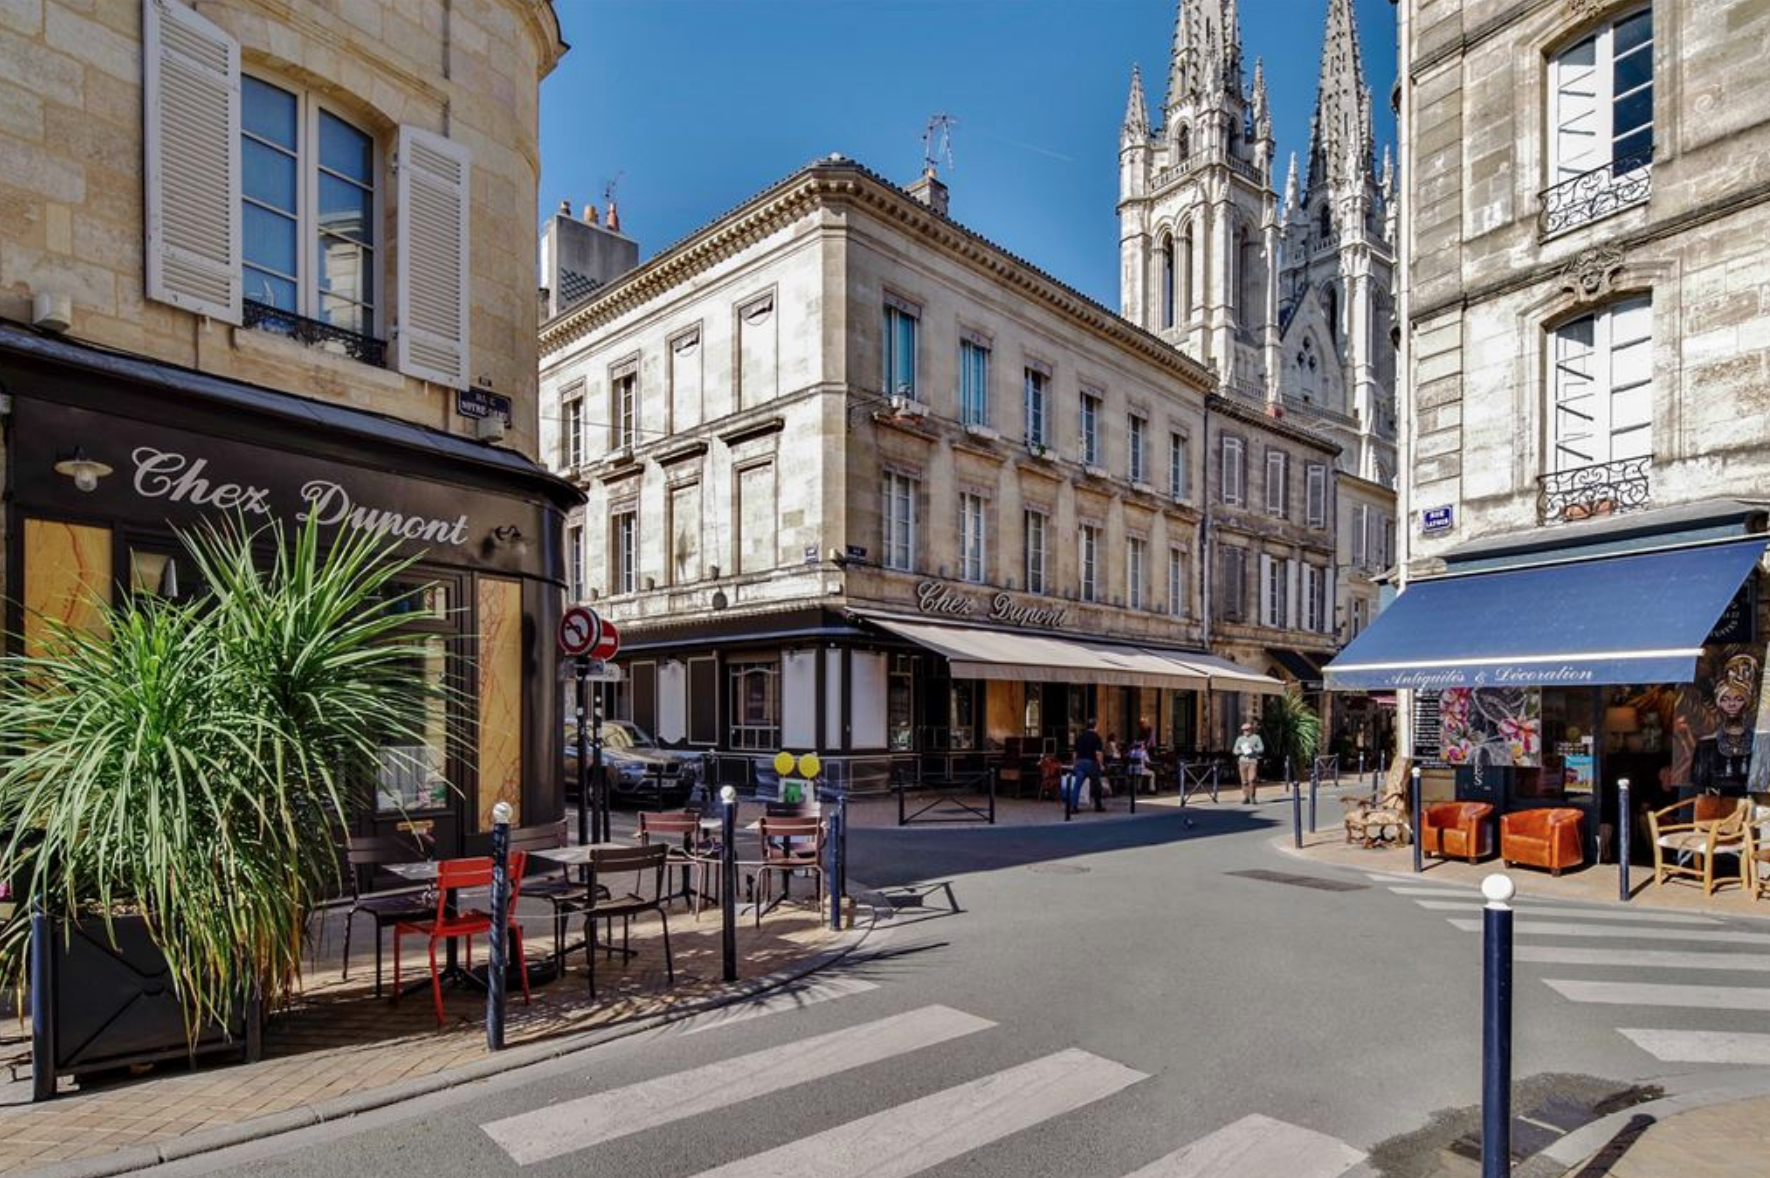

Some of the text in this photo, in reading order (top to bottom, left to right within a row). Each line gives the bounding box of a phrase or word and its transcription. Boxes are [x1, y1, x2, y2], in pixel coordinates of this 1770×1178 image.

[132, 447, 468, 546] Chez Dupont
[917, 581, 1067, 626] Chez Dupont
[1494, 665, 1592, 681] Décoration
